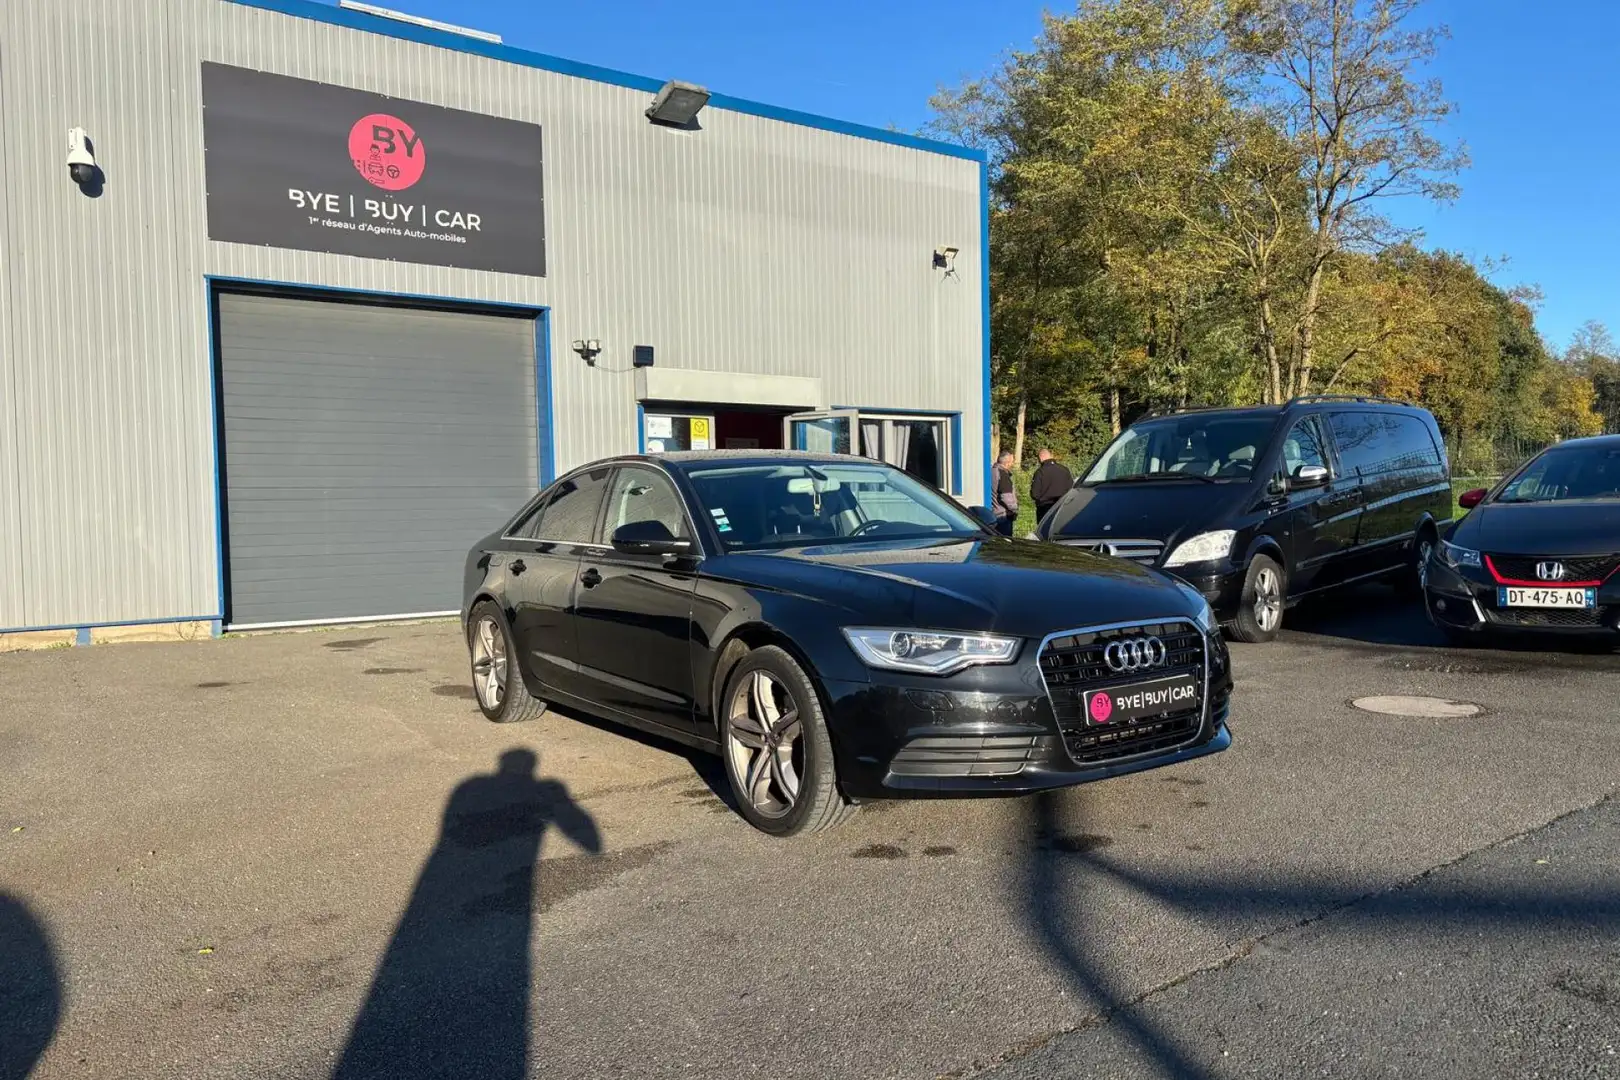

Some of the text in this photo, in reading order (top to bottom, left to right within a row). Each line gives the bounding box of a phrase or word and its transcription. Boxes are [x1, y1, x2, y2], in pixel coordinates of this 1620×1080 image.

[372, 124, 420, 158] BY
[289, 188, 340, 213] BYE
[435, 210, 481, 231] CAR
[322, 218, 356, 230] réseau
[358, 222, 401, 236] d'Agents
[403, 228, 467, 244] Auto-mobiles
[1508, 590, 1584, 605] DT-475-AQ
